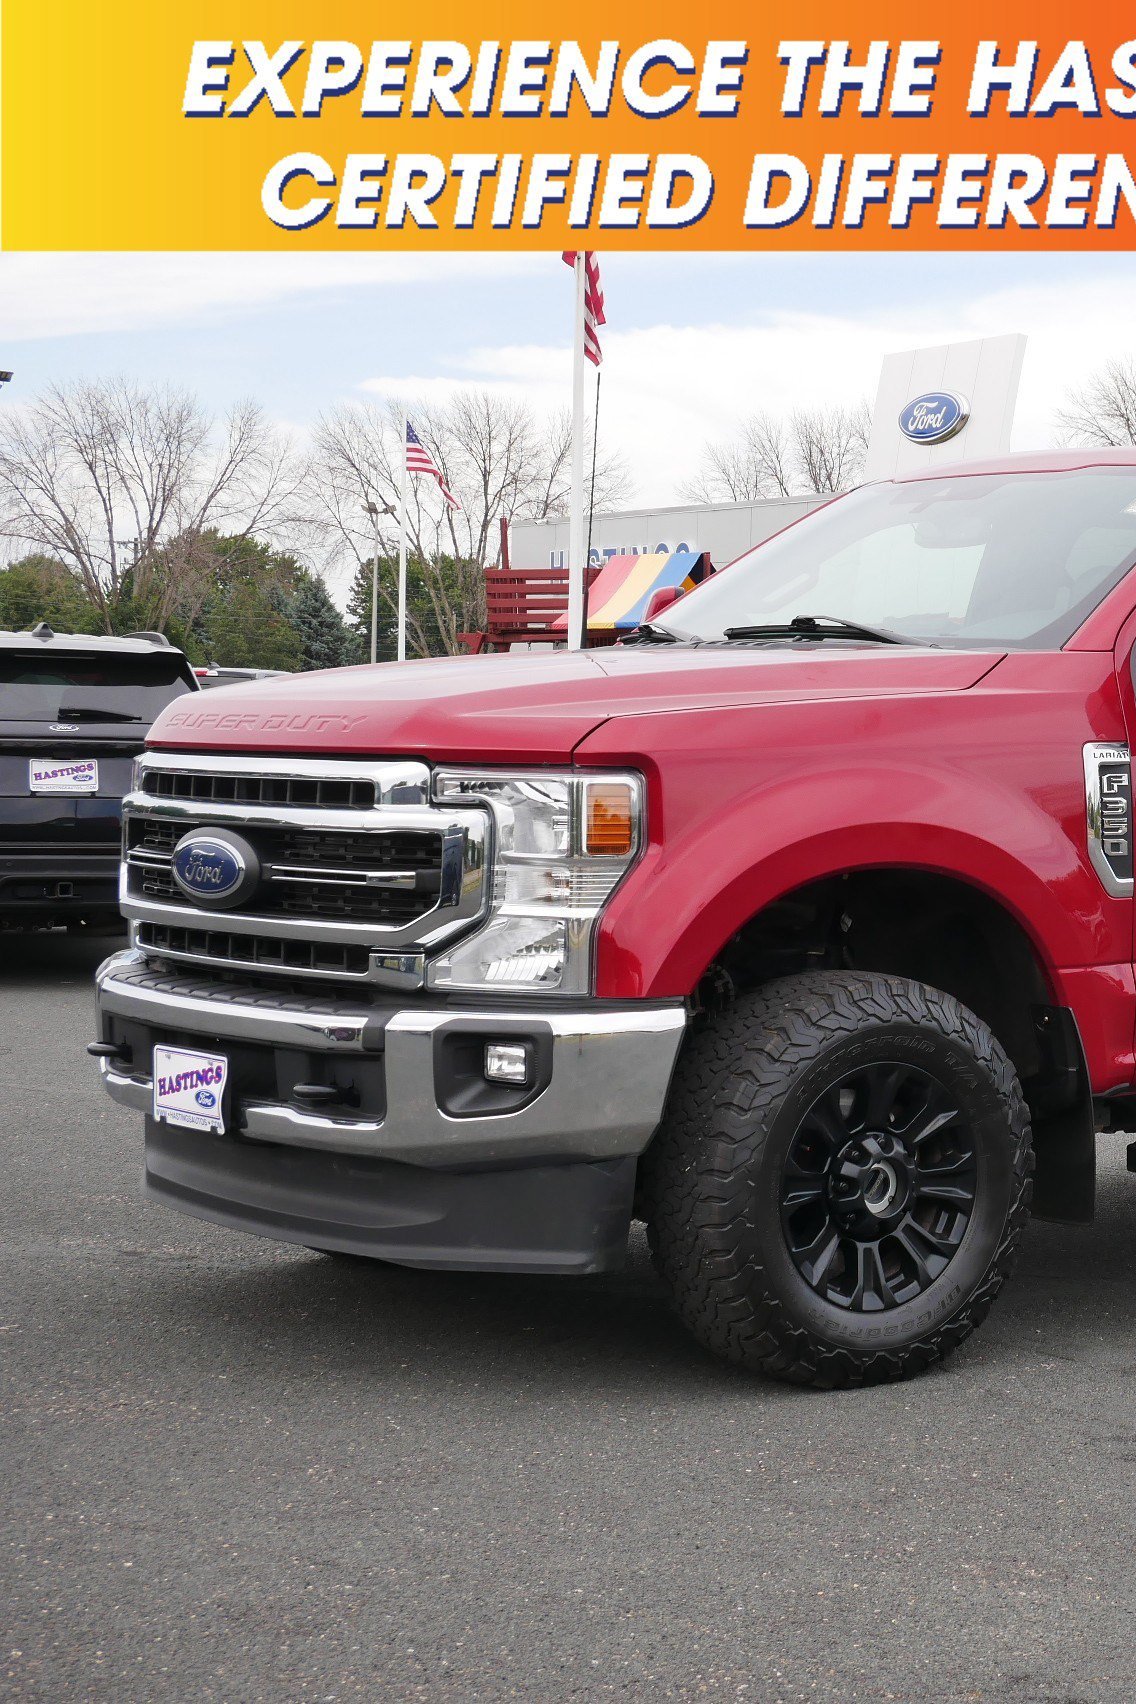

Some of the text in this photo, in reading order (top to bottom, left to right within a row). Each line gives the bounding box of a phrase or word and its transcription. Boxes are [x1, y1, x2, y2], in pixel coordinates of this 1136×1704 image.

[907, 400, 948, 431] Ford
[166, 712, 369, 733] SUPER DUTY
[1093, 750, 1130, 760] LARIAT
[33, 762, 95, 781] HASTINGS
[184, 849, 225, 884] Ford
[158, 1065, 223, 1097] HASTINGS
